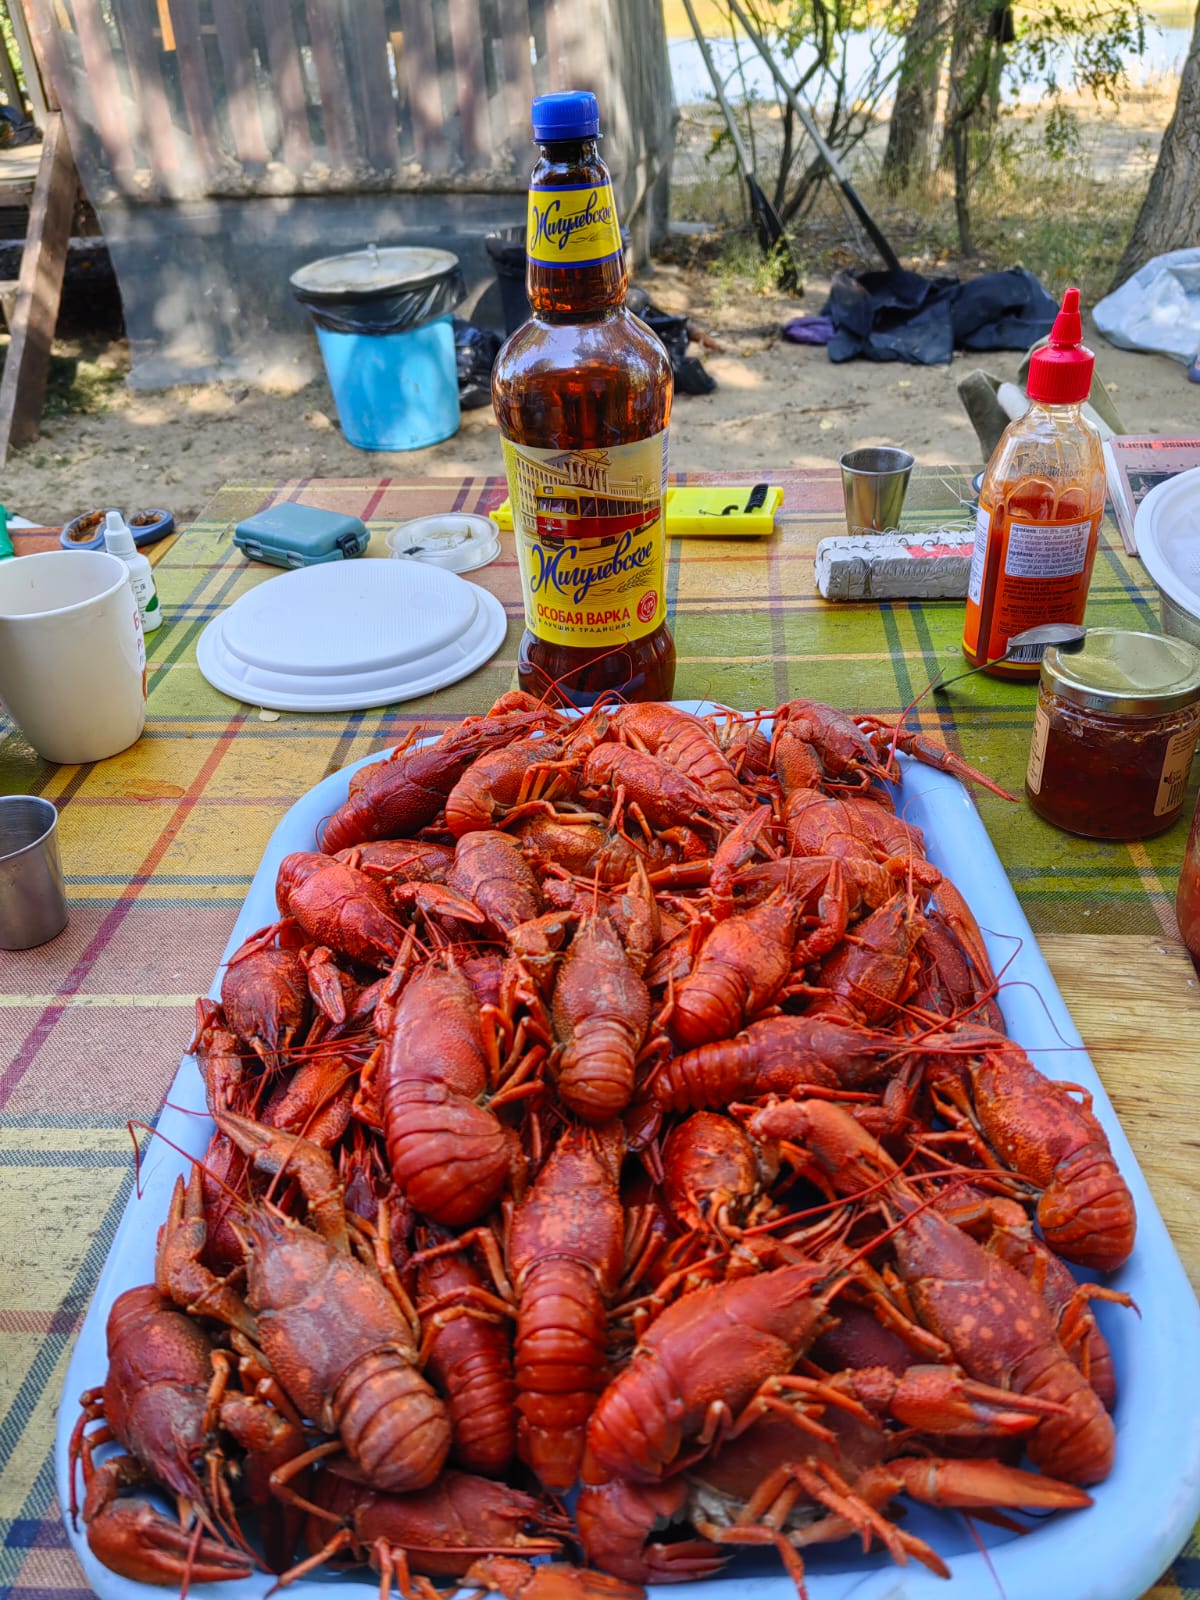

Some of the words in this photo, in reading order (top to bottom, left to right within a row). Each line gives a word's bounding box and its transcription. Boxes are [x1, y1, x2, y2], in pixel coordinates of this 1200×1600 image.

[530, 531, 655, 605] Жигулевское
[537, 603, 583, 625] ОСОБАЯ
[586, 607, 631, 626] ВАРКА
[543, 620, 576, 632] ЛУЧШИХ
[579, 621, 632, 633] ТРАДИЦИЯХ
